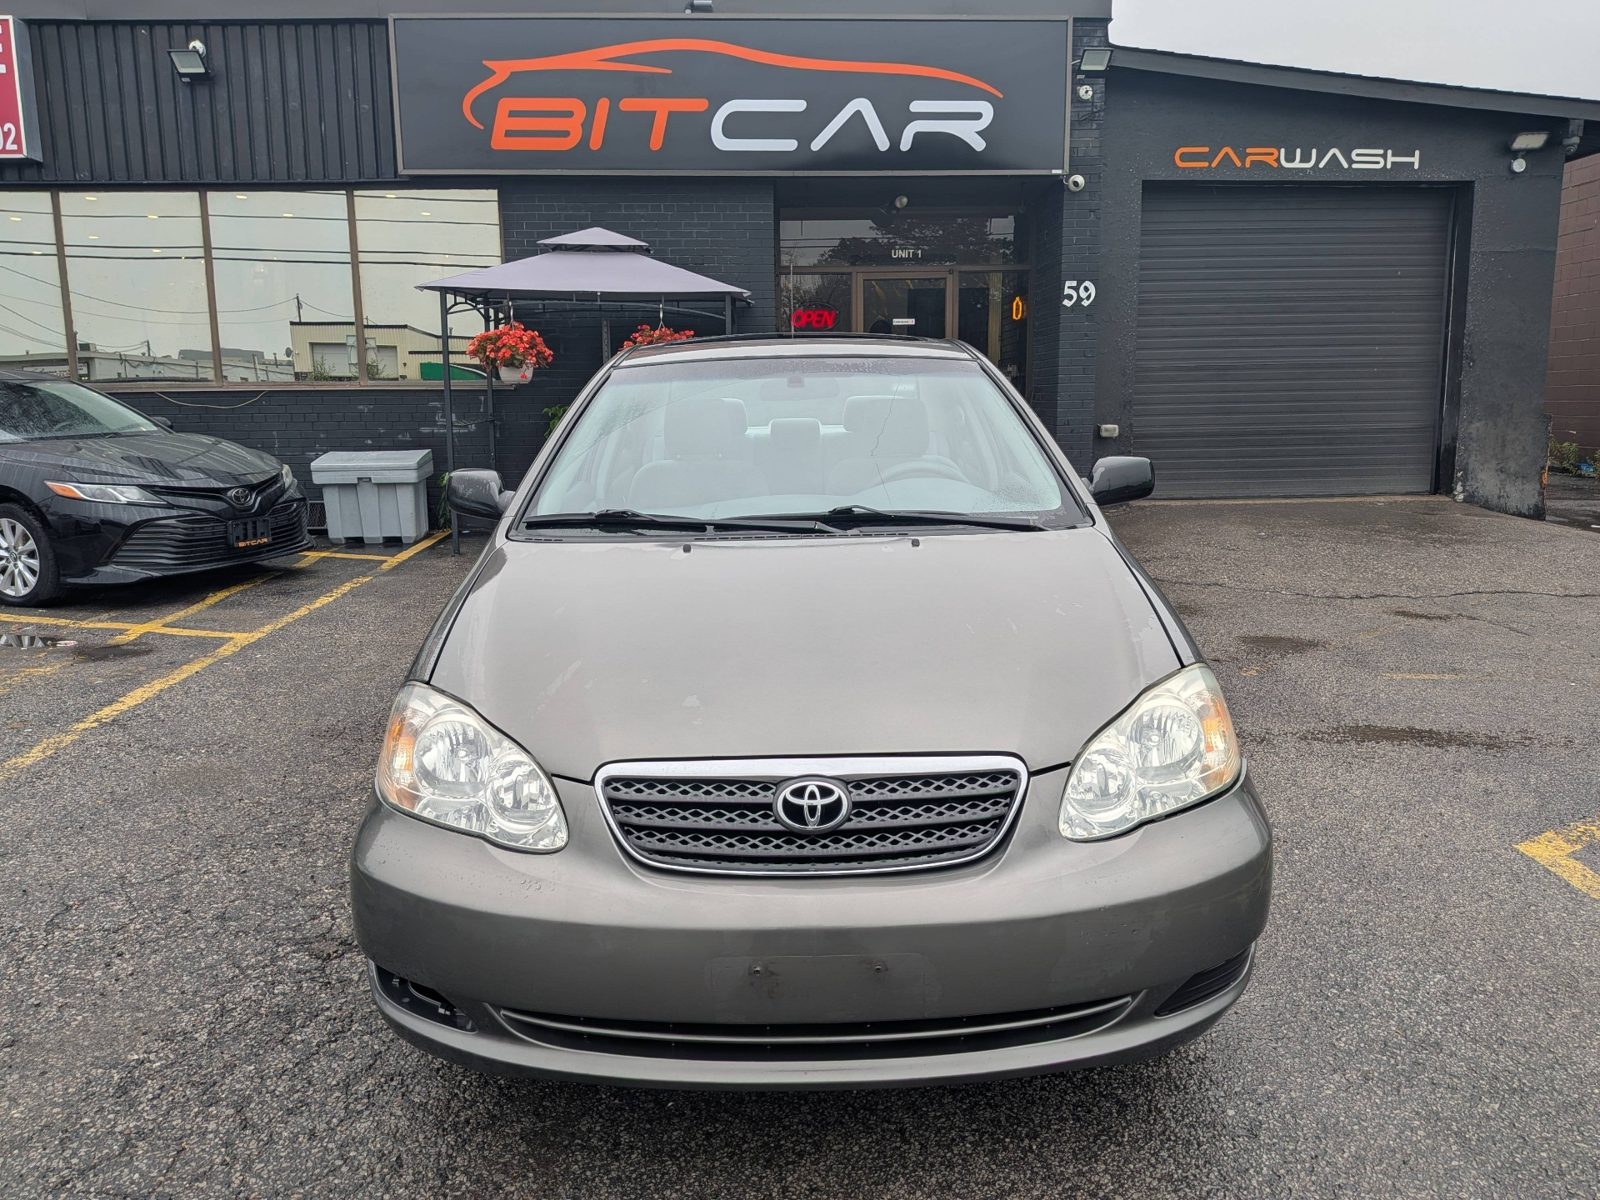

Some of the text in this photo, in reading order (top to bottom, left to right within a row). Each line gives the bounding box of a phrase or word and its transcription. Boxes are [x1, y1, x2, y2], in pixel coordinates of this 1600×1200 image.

[0, 122, 18, 151] 2
[490, 97, 994, 152] BITCAR
[1174, 146, 1420, 170] CARWASH
[891, 249, 922, 258] UNIT 1
[1062, 280, 1096, 307] 59
[791, 309, 837, 329] OPEN
